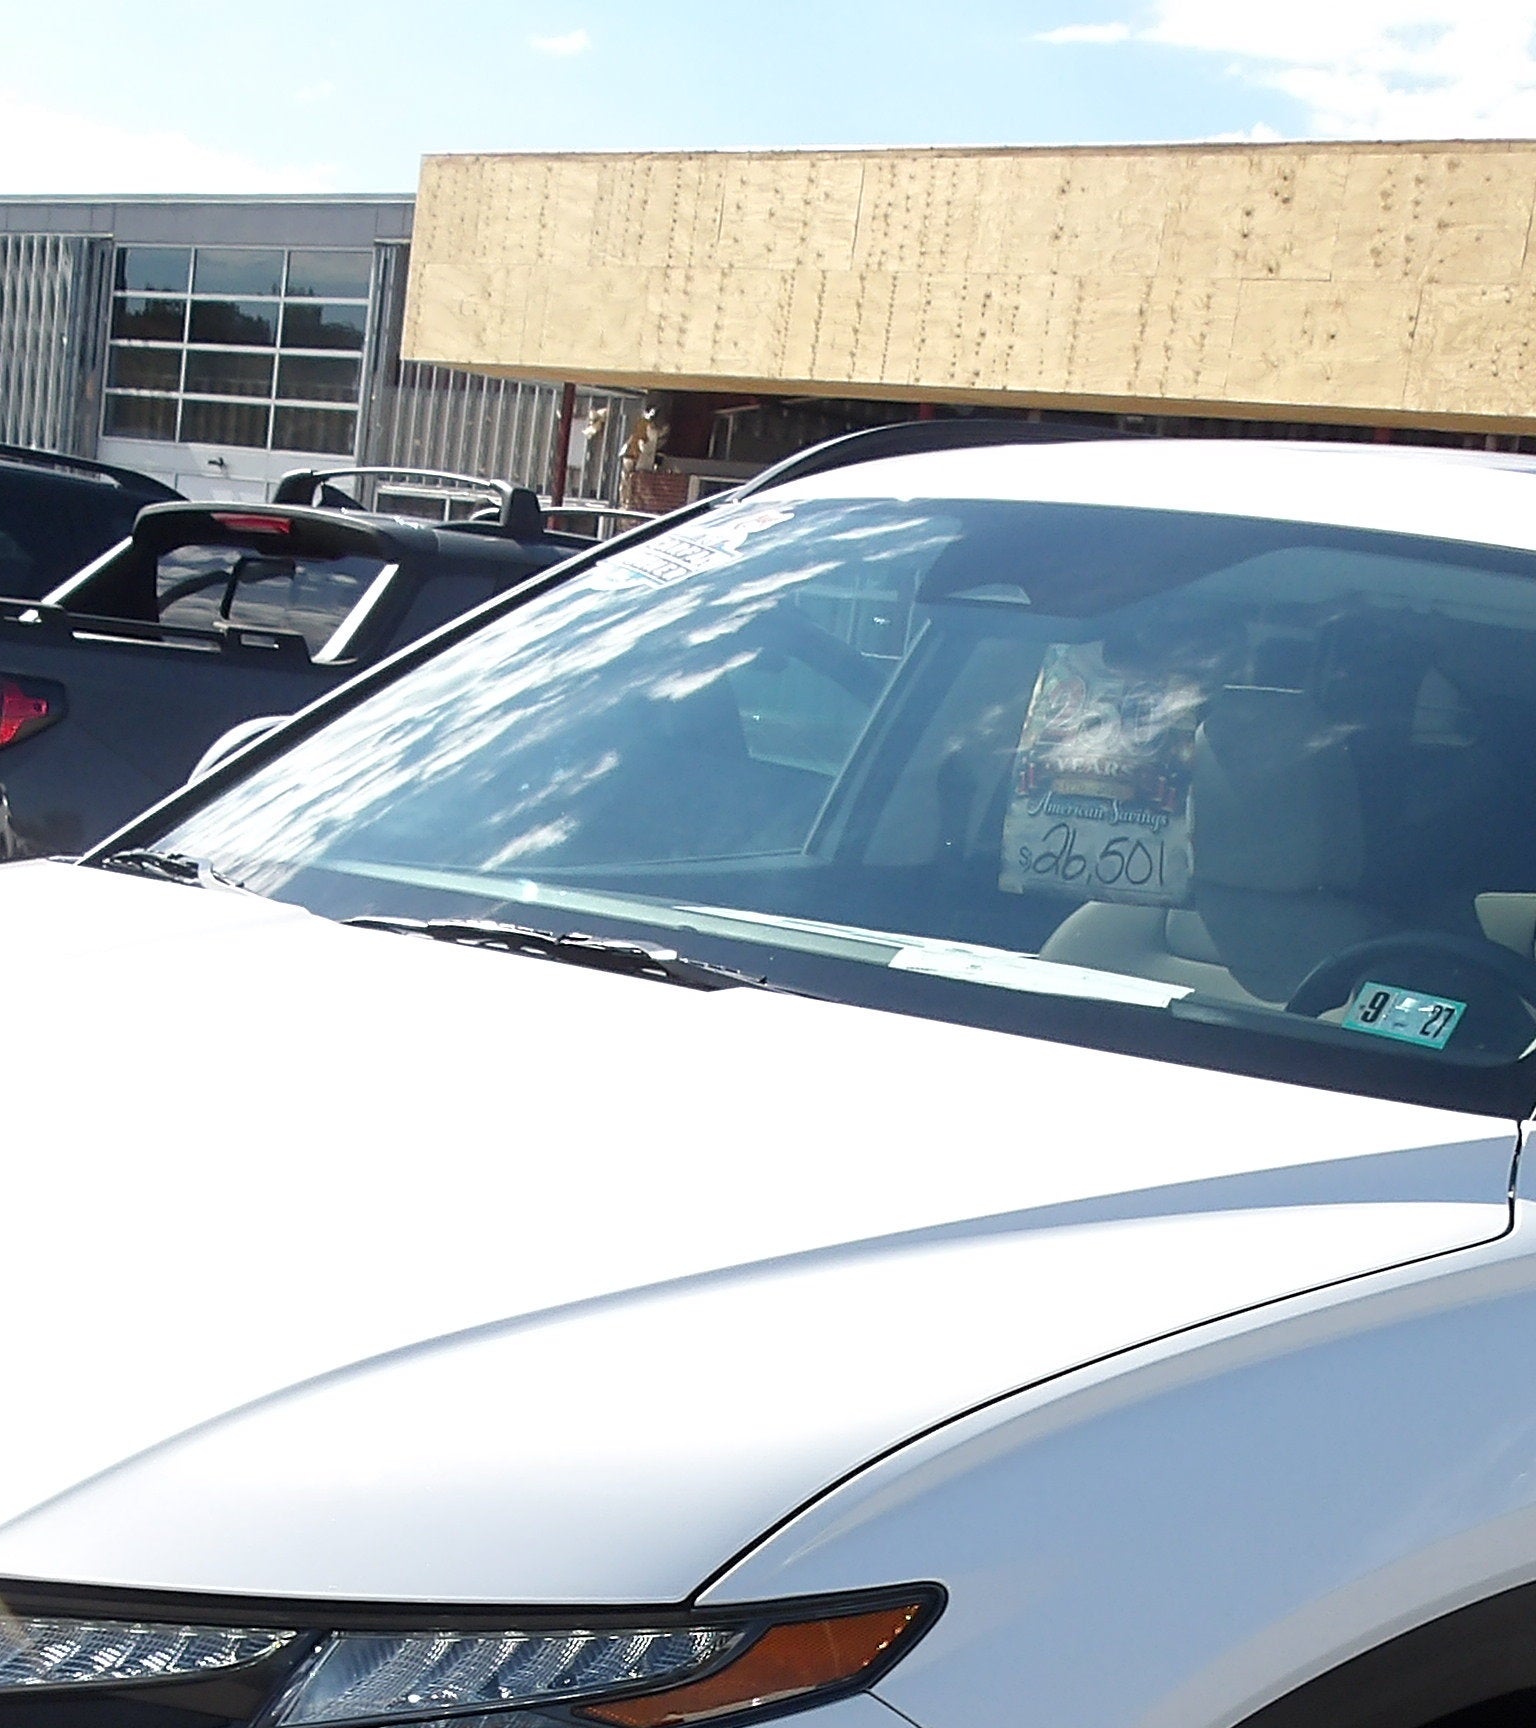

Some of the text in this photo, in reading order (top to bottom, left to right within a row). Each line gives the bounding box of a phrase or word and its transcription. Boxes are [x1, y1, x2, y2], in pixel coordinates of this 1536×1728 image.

[1028, 790, 1170, 834] American Savings
[1018, 822, 1166, 887] $26,501
[1361, 991, 1455, 1038] 9 27
